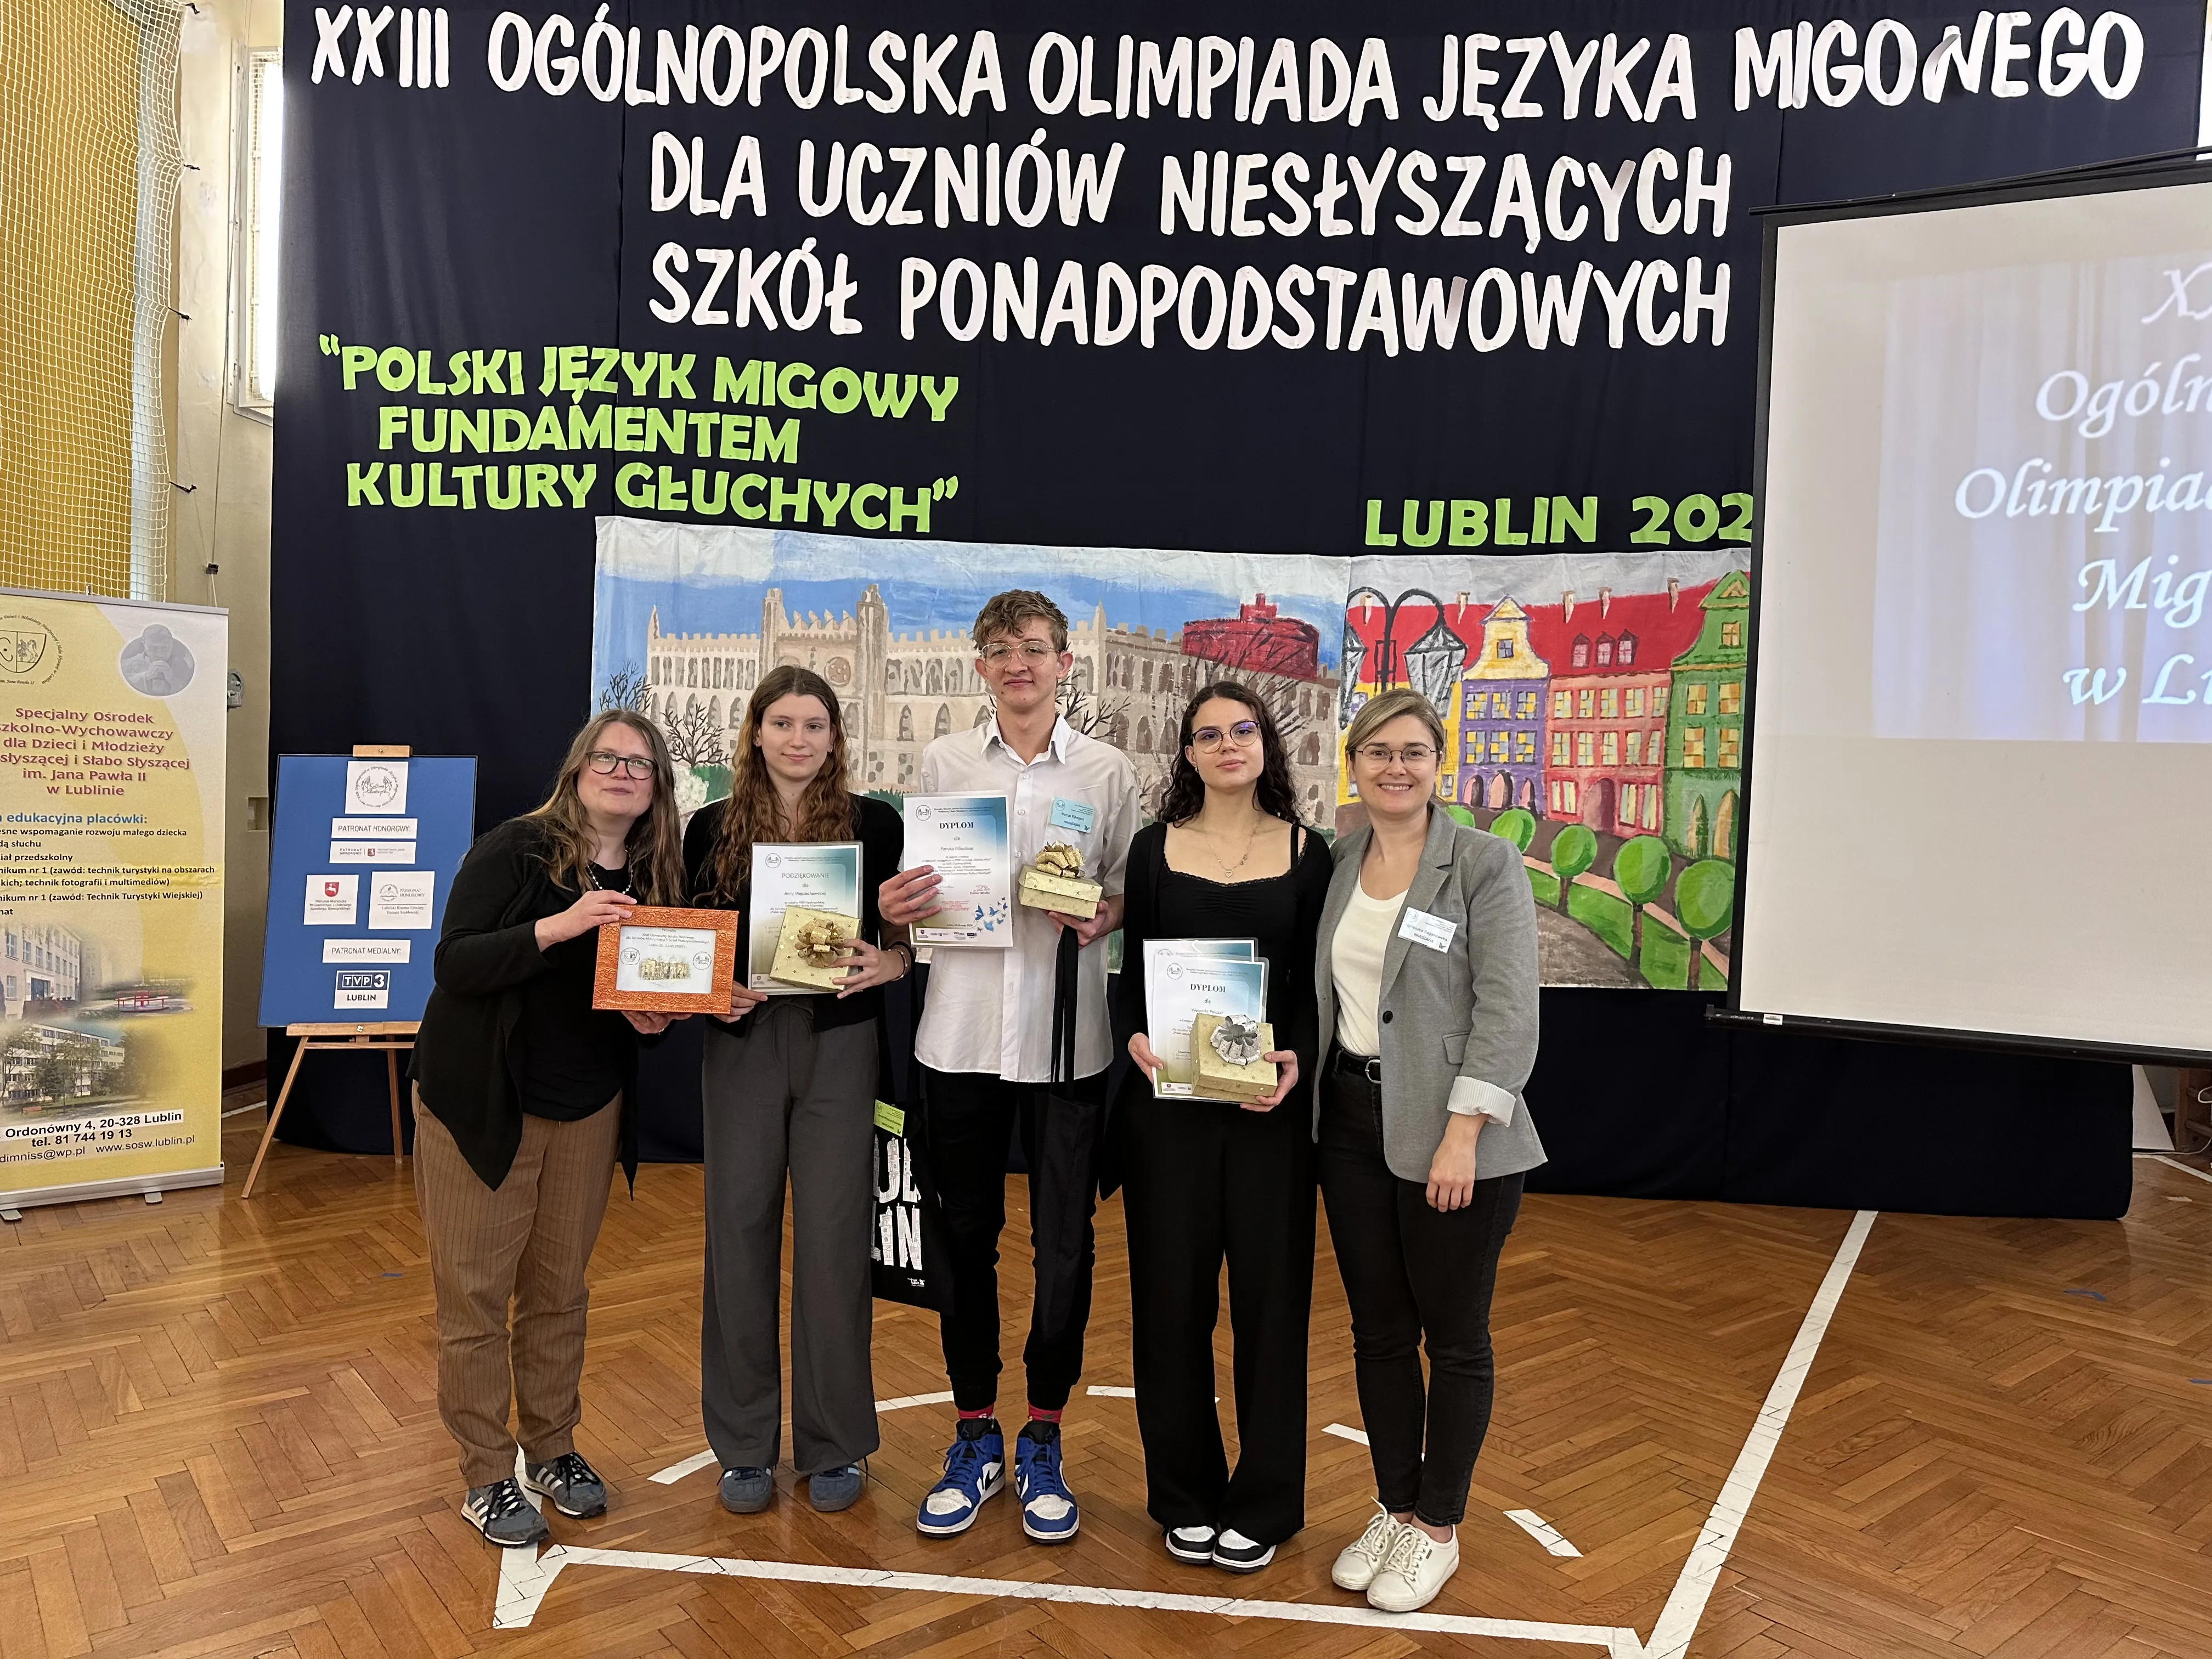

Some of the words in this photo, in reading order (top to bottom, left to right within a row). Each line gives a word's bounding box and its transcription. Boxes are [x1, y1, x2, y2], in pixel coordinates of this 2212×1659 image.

[311, 5, 449, 88] XXIII
[488, 3, 1006, 117] OGÓLNOPOLSKA
[1029, 32, 1398, 127] OLIMPIADA
[1423, 31, 1696, 131] JĘZYKA
[651, 131, 766, 219] DLA
[799, 128, 1125, 228] UCZNIÓW
[1161, 147, 1731, 253] NIESŁYSZĄCYCH
[650, 238, 862, 335] SZKÓŁ
[901, 257, 1730, 357] PONADPODSTAWOWYCH
[540, 346, 695, 404] JĘZYK
[713, 356, 959, 422] MIGOWY
[379, 405, 800, 464] FUNDAMENTEM
[347, 462, 596, 509] KULTURY
[1365, 495, 1598, 548] LUBLIN
[2063, 667, 2127, 705] w
[16, 708, 88, 721] Specjalny
[94, 712, 154, 723] Ośrodek
[0, 722, 173, 740] zkolno-Wychowawczy
[3, 738, 26, 748] dla
[32, 738, 77, 749] Dzieci
[82, 740, 86, 750] i
[92, 741, 164, 754] Młodzieży
[74, 754, 78, 765] i
[83, 755, 122, 766] Słabo
[127, 758, 190, 770] Słyszącej
[22, 768, 46, 778] im.
[51, 770, 84, 781] Jana
[89, 771, 133, 781] Pawła
[138, 772, 146, 781] II
[47, 786, 60, 794] w
[66, 785, 125, 795] Lublinie
[7, 812, 82, 825] edukacyjna
[87, 813, 147, 825] placówki:
[86, 828, 120, 837] rozwoju
[123, 828, 154, 837] małego
[14, 854, 73, 862] przedszkolny
[50, 866, 85, 875] (zawód:
[61, 879, 101, 887] fotografii
[110, 878, 170, 887] multimediów)
[49, 893, 84, 902] (zawód:
[87, 893, 119, 901] Technik
[122, 892, 160, 900] Turystyki
[162, 891, 202, 900] Wiejskiej)
[1190, 983, 1226, 992] DYPLOM
[5, 1124, 81, 1138] Ordonówny
[85, 1120, 95, 1130] 4,
[100, 1116, 140, 1128] 20-328
[144, 1112, 182, 1124] Lublin
[32, 1137, 51, 1147] tel.
[55, 1135, 69, 1144] 81
[74, 1132, 96, 1143] 744
[100, 1130, 114, 1140] 19
[119, 1128, 132, 1138] 13
[96, 1135, 195, 1153] www.sosw.lublin.pl
